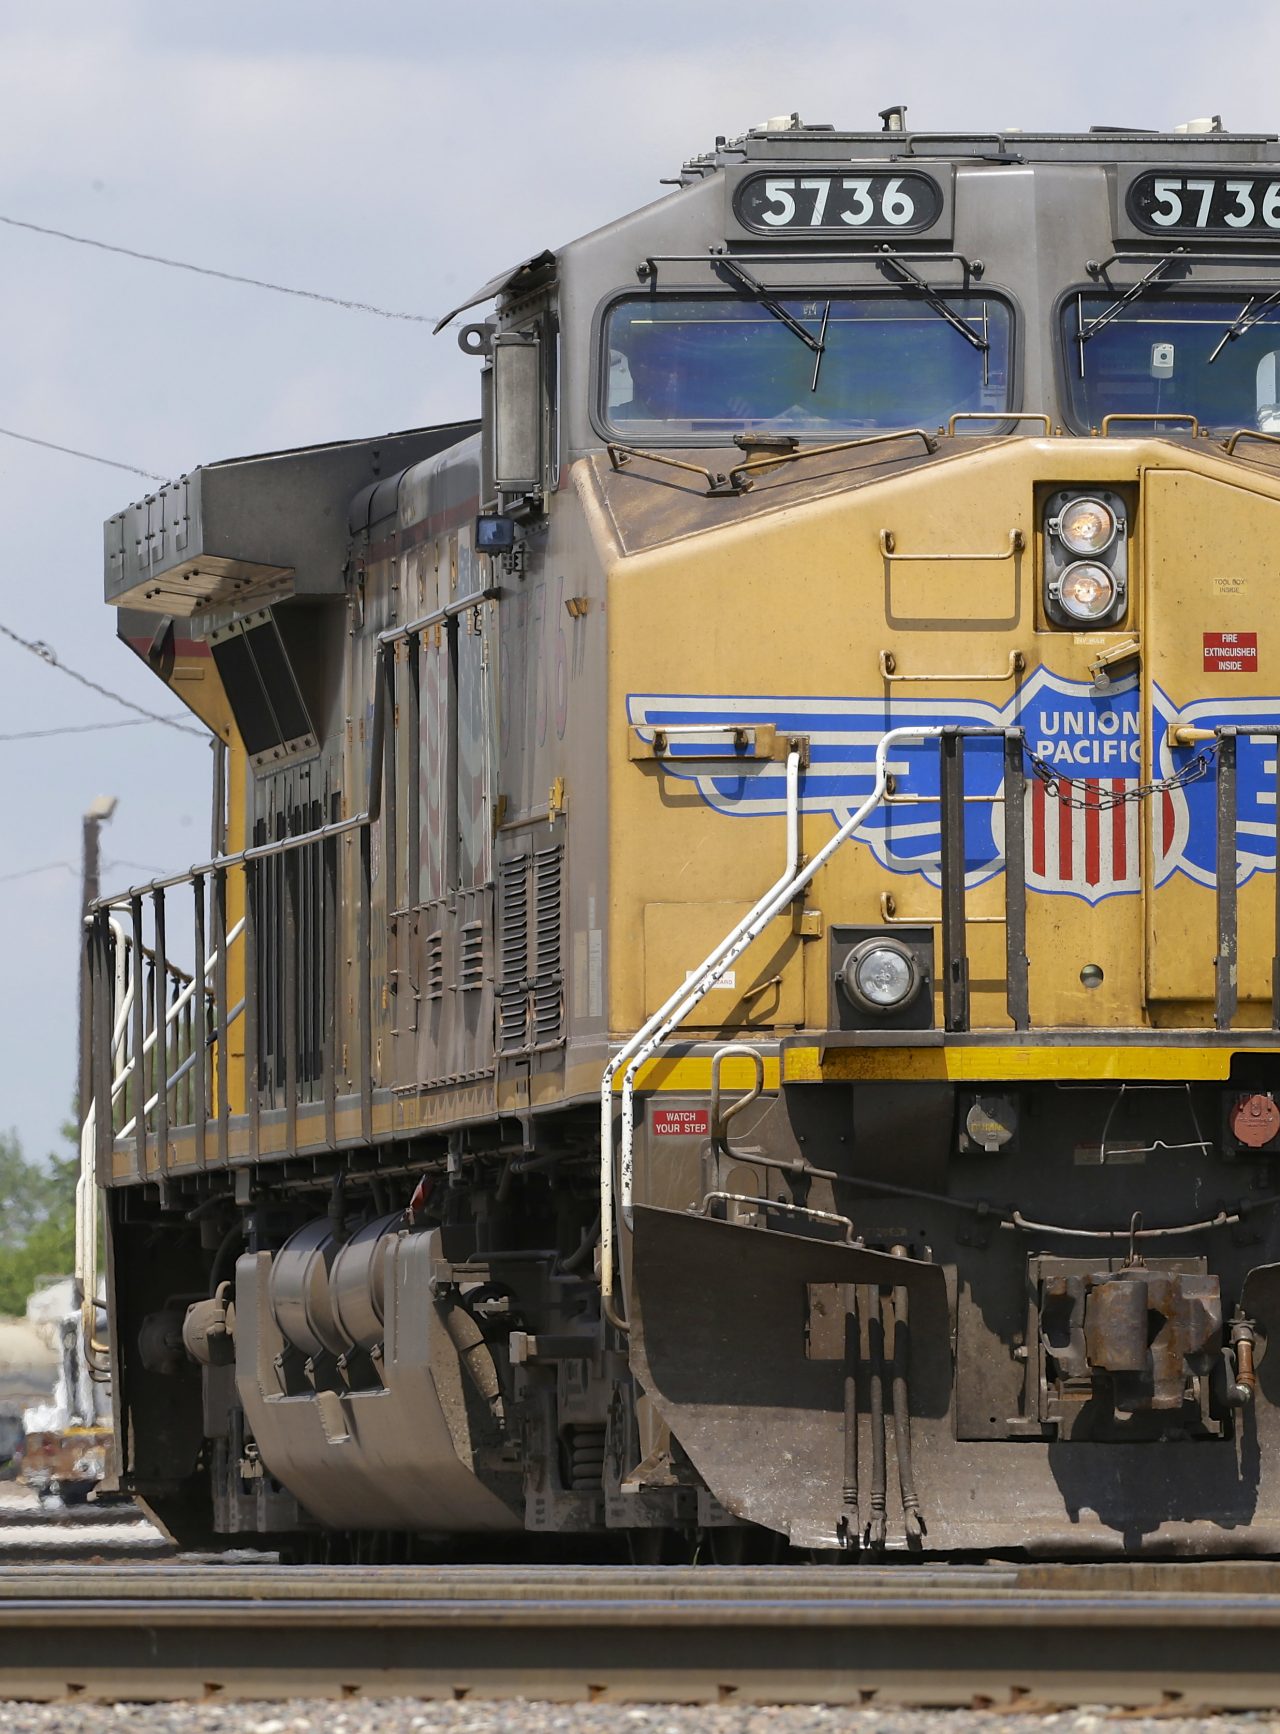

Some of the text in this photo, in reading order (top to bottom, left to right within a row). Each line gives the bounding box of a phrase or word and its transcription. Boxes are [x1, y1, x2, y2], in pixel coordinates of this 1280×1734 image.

[761, 177, 915, 226] 5736
[1213, 578, 1231, 586] TOOL
[1221, 633, 1238, 643] FIRE
[1204, 647, 1257, 657] EXTINGUISHER
[1218, 661, 1243, 671] INSIDE
[1040, 710, 1140, 736] UNION
[1036, 739, 1140, 764] PACIFIC
[666, 1112, 697, 1122] WATCH
[655, 1123, 707, 1133] YOUR STEP
